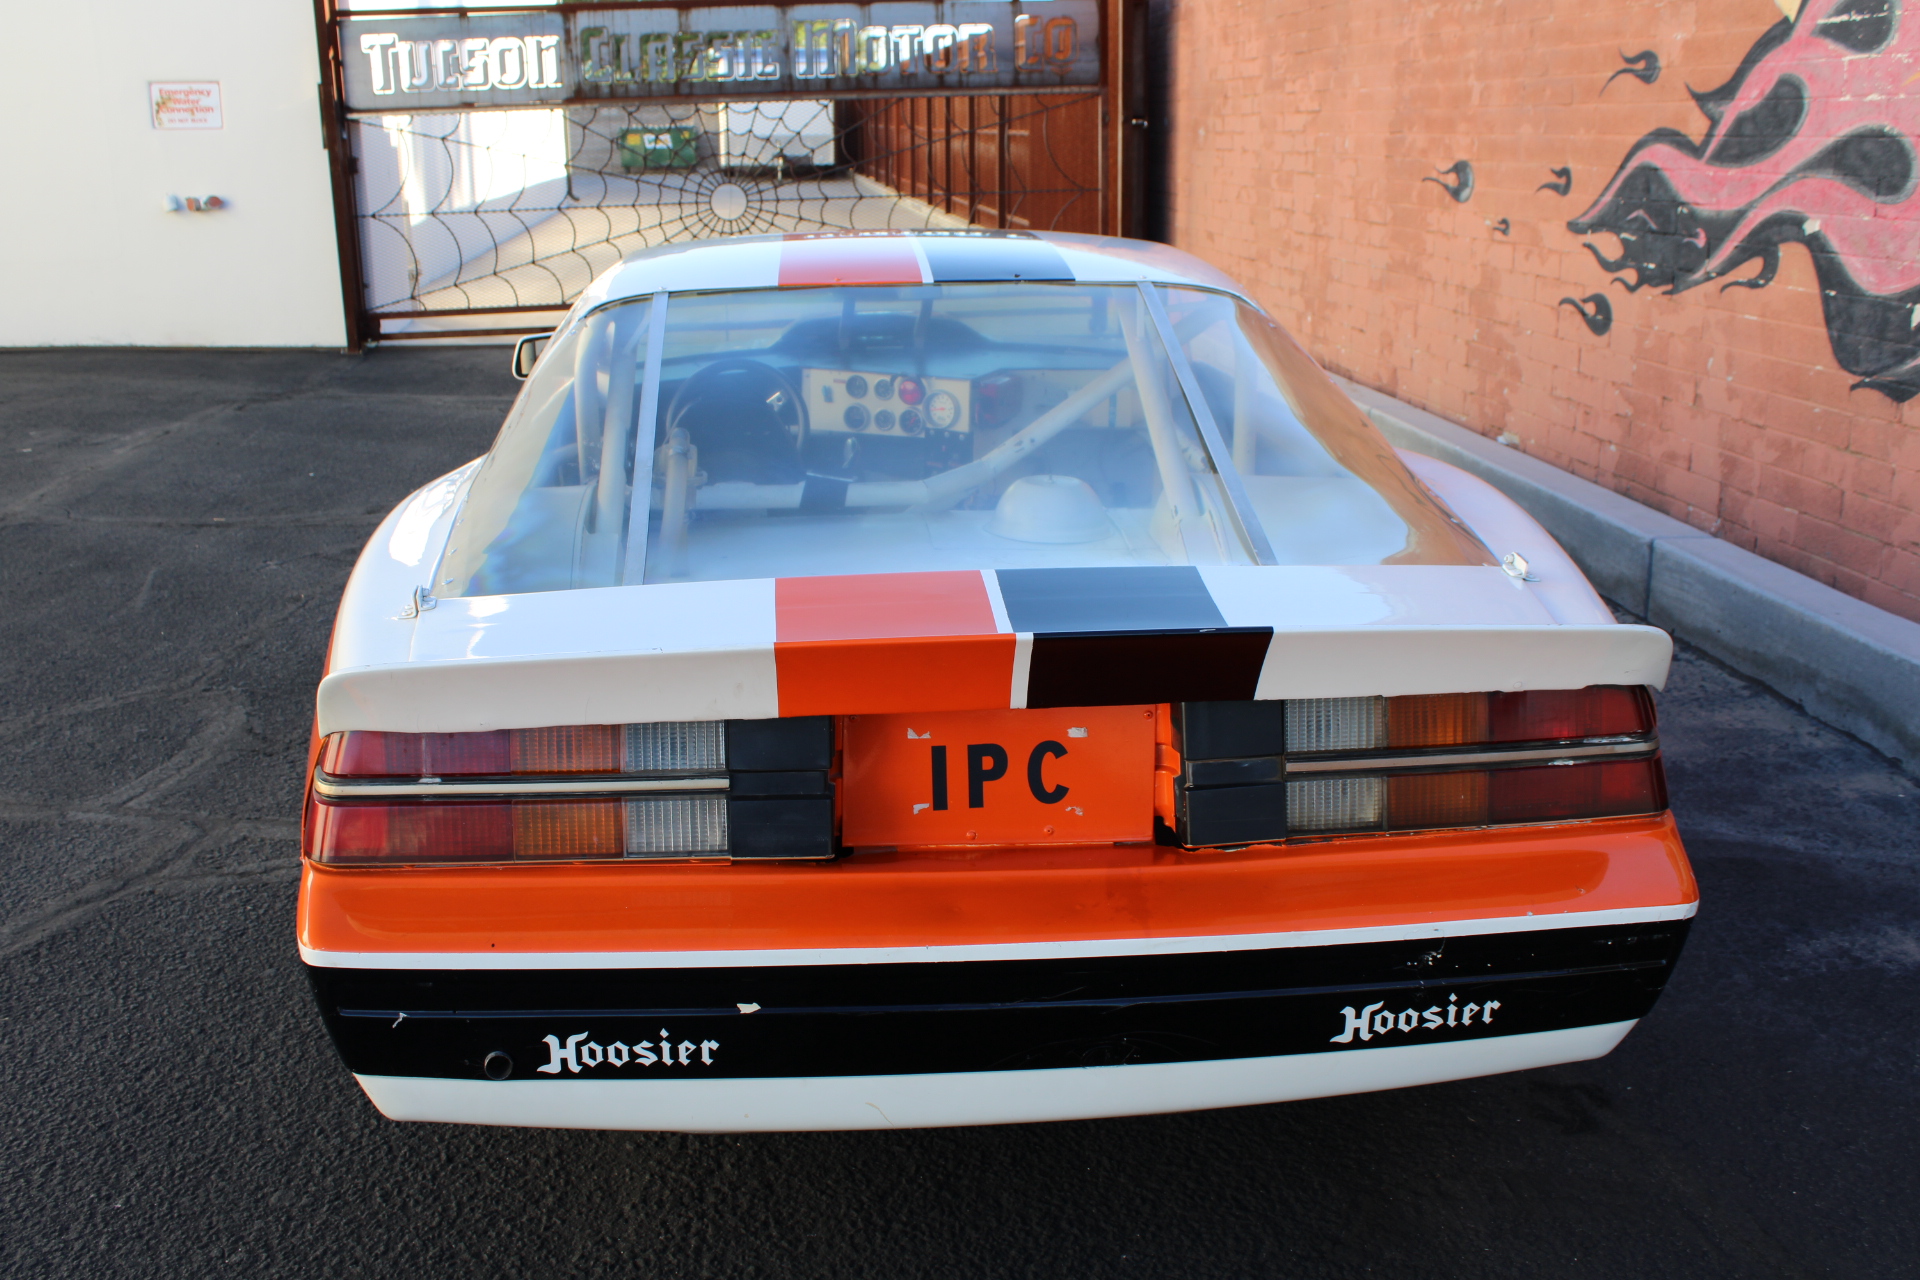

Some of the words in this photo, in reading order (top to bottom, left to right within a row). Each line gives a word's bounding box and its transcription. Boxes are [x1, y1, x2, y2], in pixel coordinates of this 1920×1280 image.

[159, 88, 211, 97] Emergency
[931, 739, 1070, 811] IPC
[1329, 992, 1502, 1044] Hoosier
[536, 1027, 720, 1075] Hoosier
